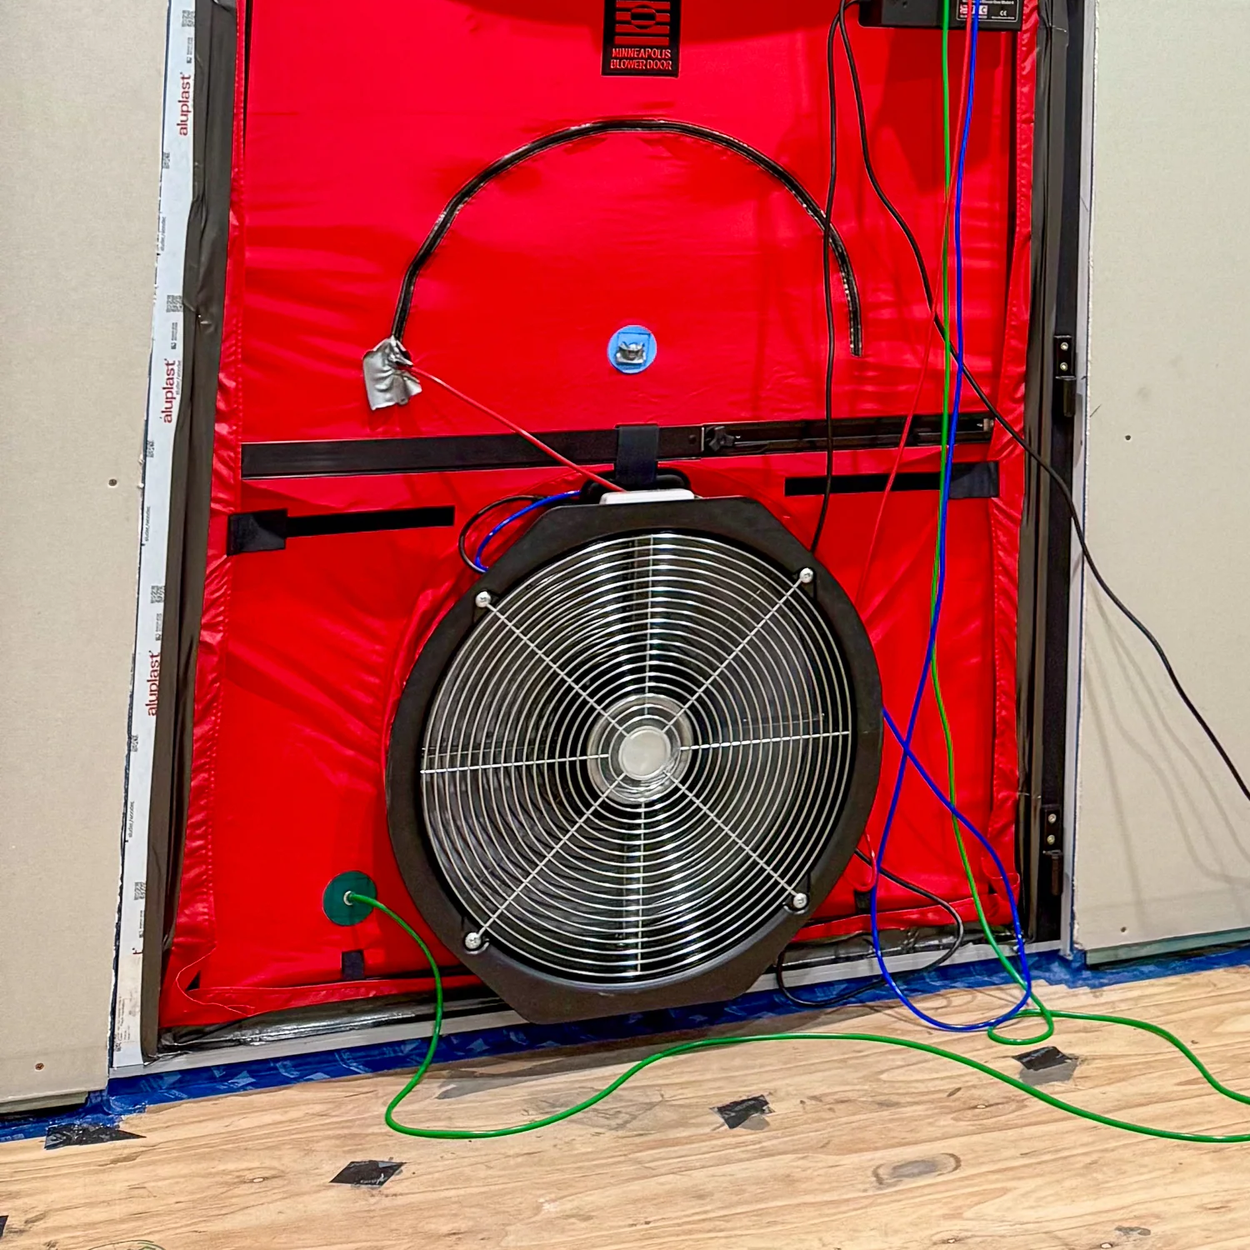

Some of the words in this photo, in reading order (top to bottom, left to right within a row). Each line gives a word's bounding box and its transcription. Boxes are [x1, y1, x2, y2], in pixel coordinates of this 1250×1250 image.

[610, 59, 646, 70] BLOWER
[647, 60, 672, 70] DOOR
[612, 48, 672, 59] MINNEAPOLIS
[176, 72, 192, 136] aluplast
[161, 358, 177, 424] aluplast
